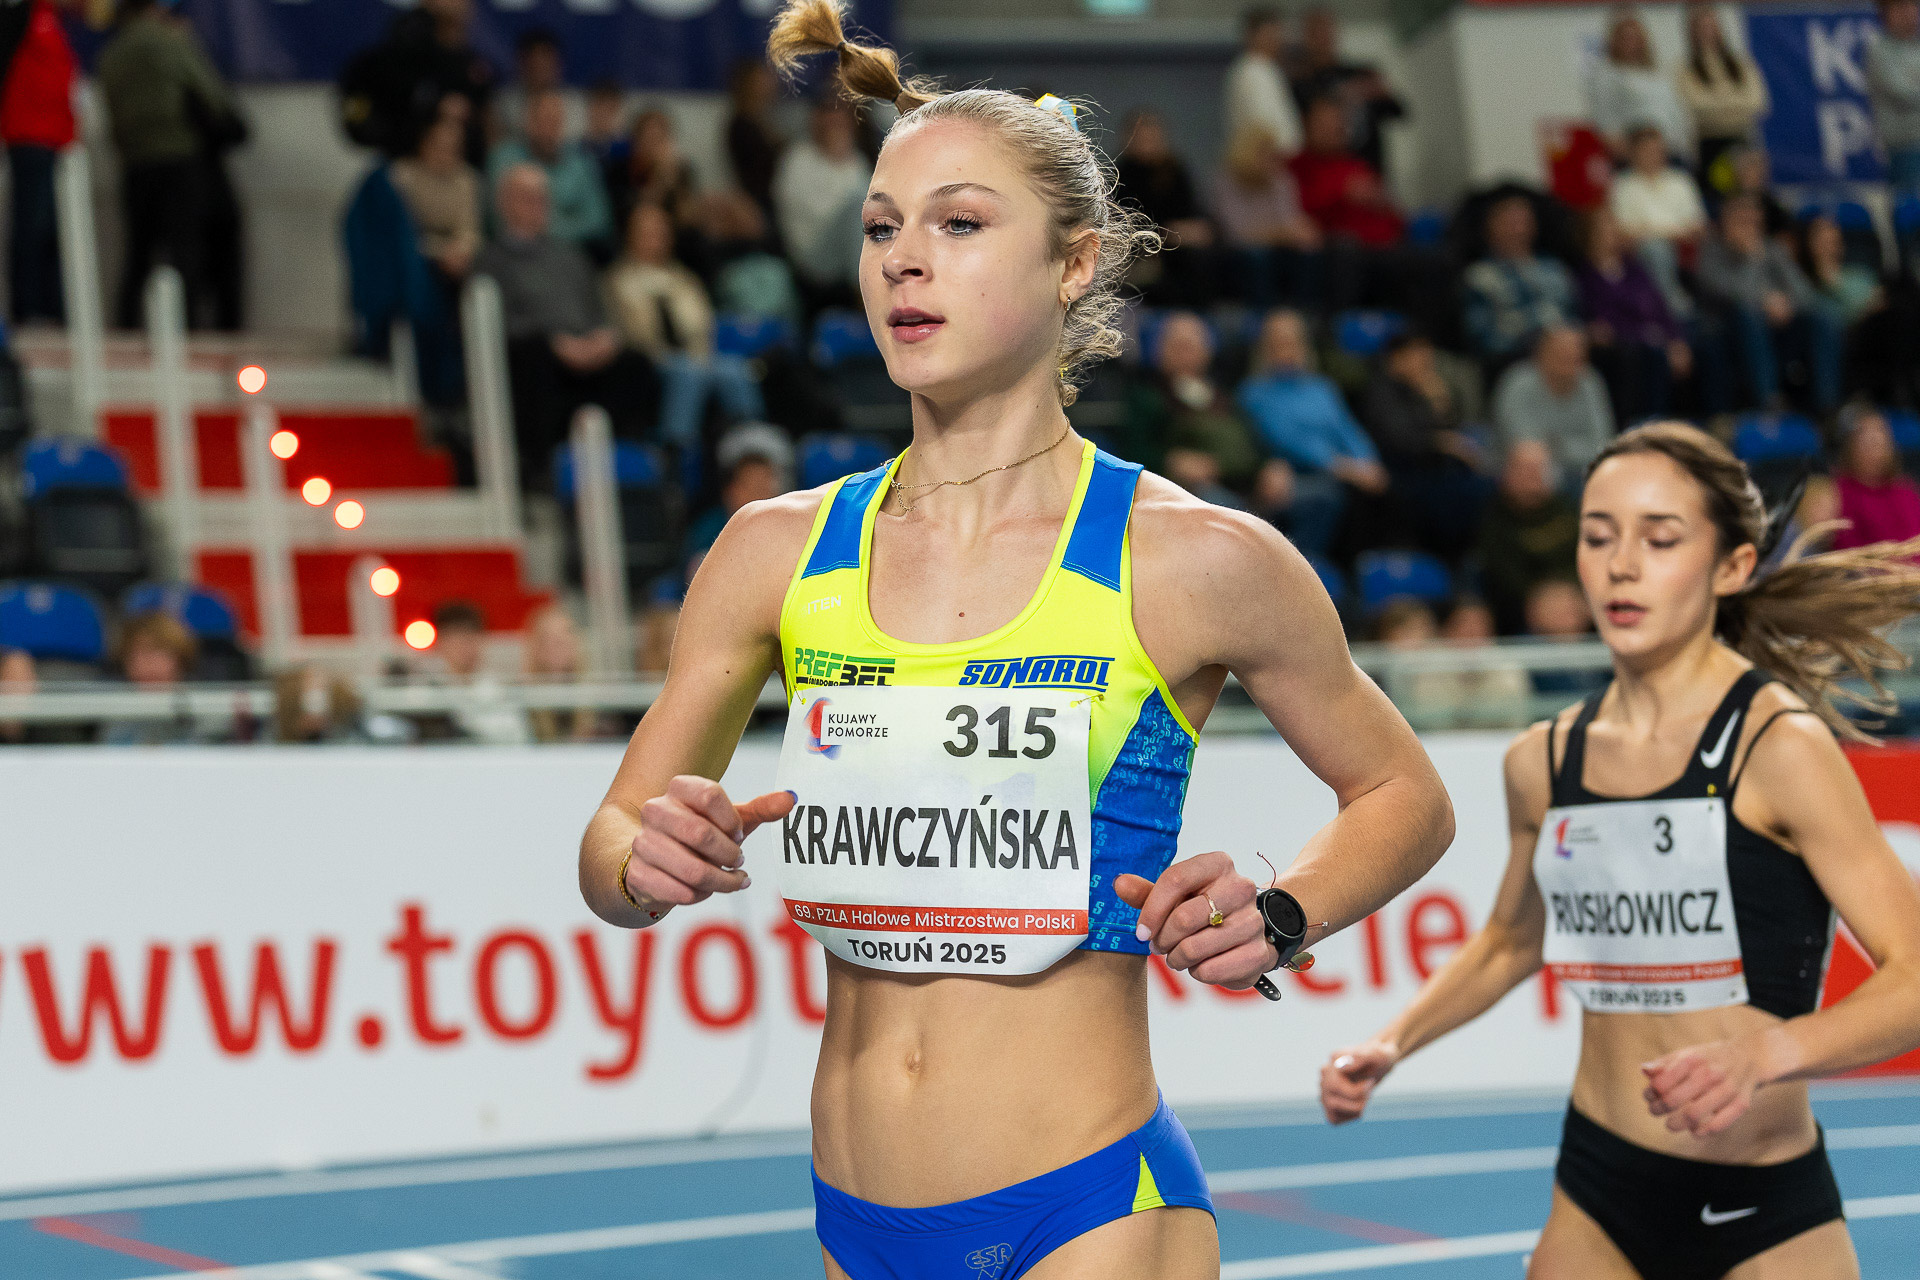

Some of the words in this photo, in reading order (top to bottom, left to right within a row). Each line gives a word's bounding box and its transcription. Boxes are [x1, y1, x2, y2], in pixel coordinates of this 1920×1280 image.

[958, 654, 1116, 692] SONAROL
[828, 713, 877, 724] KUJAWY
[828, 727, 889, 738] POMORZE
[942, 704, 1057, 759] 315
[783, 794, 1080, 870] KRAWCZYŃSKA
[1653, 815, 1674, 853] 3
[794, 904, 815, 920] 69.
[817, 908, 849, 924] PZLA
[851, 910, 910, 927] Halowe
[915, 911, 1020, 929] Mistrzostwa
[1024, 914, 1077, 930] Polski
[847, 936, 933, 963] TORUŃ
[940, 942, 1007, 965] 2025
